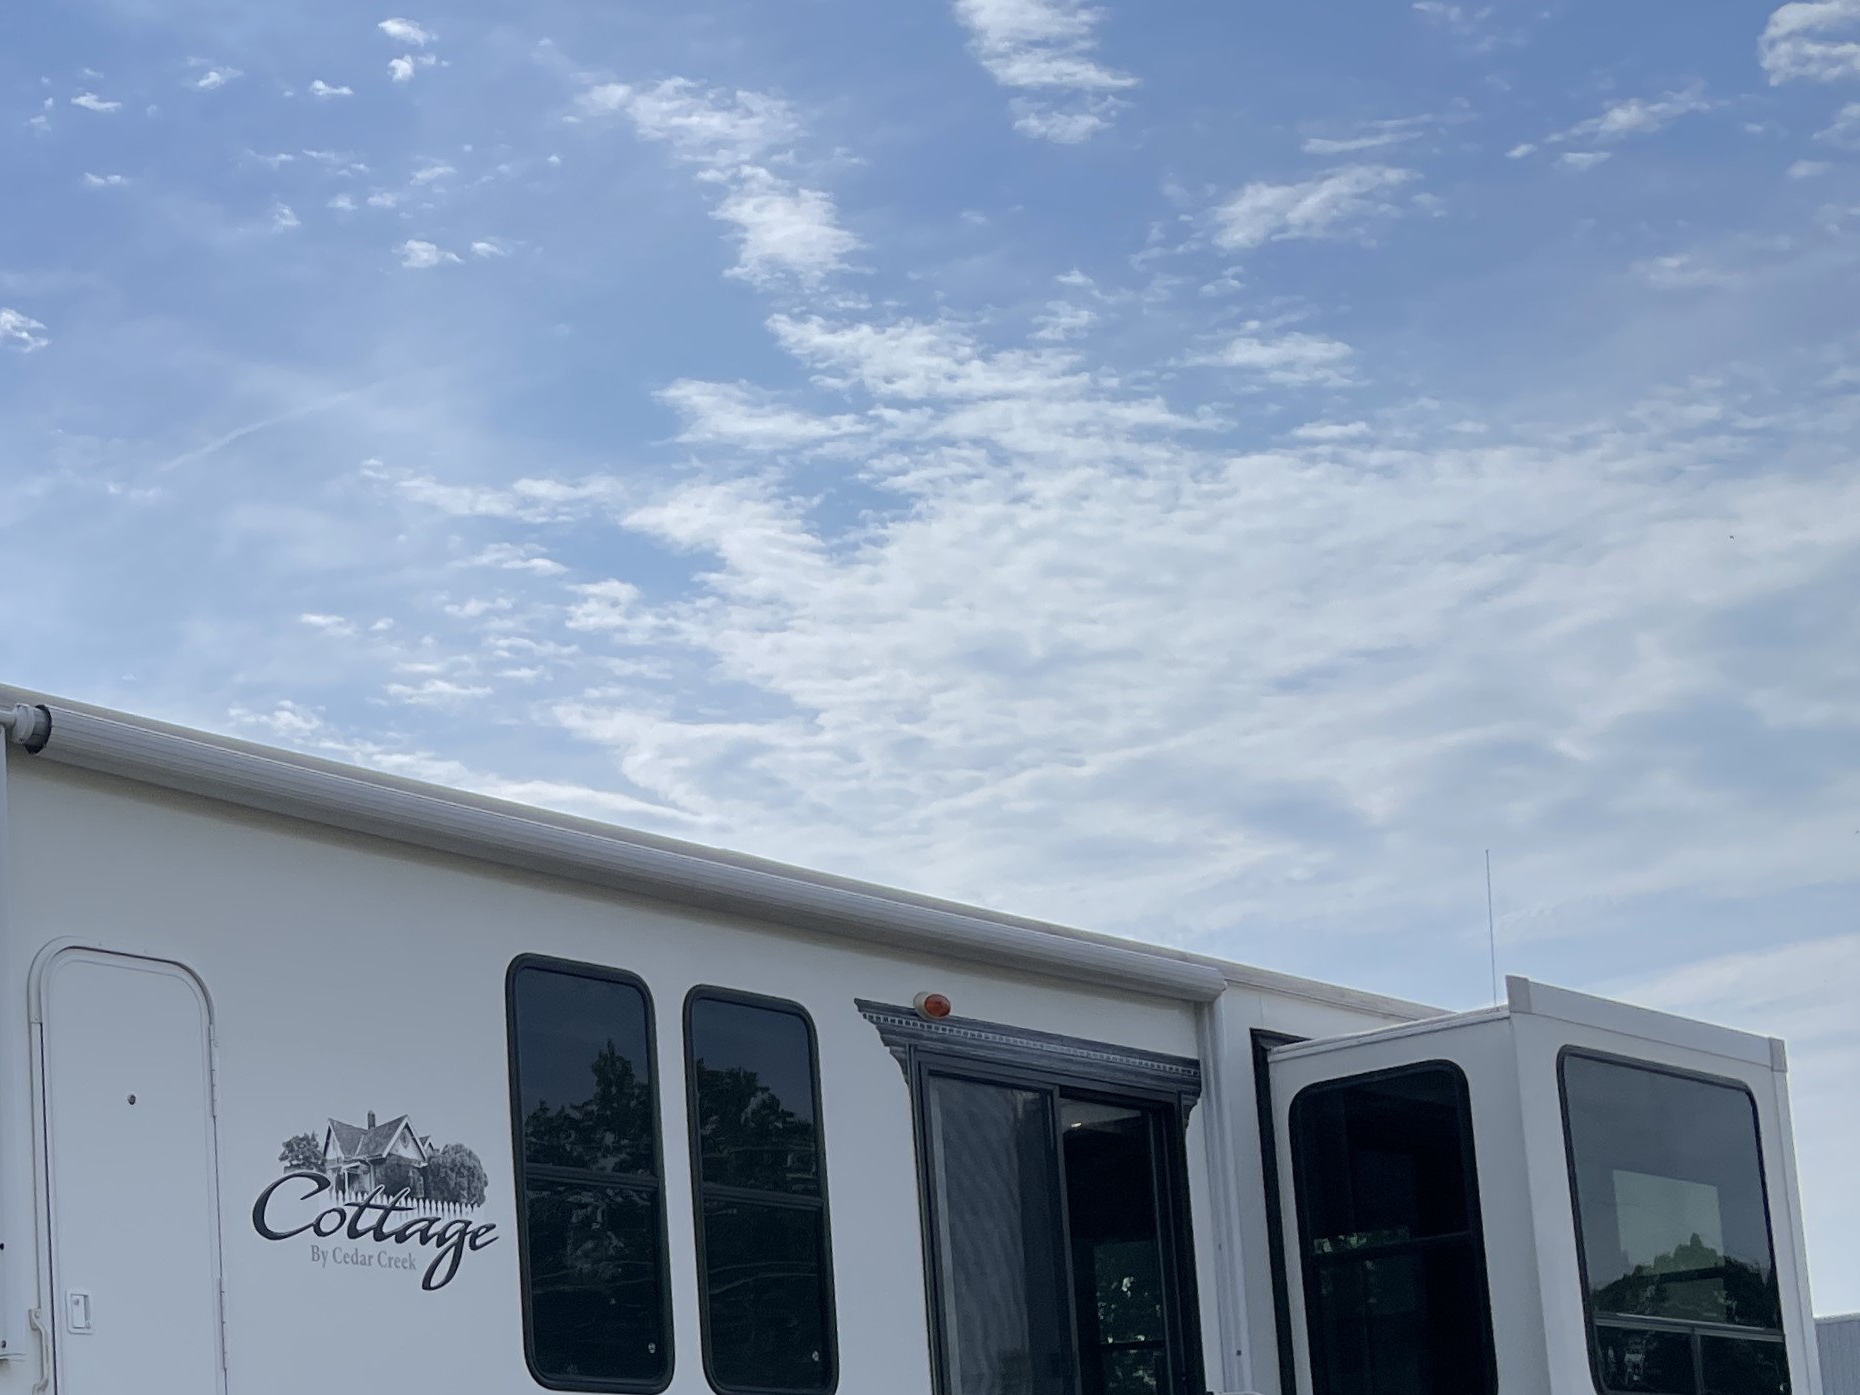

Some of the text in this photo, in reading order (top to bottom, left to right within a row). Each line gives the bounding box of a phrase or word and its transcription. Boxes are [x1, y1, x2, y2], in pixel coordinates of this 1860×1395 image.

[252, 1171, 499, 1291] Cottage
[311, 1244, 417, 1270] By Cedar Creek
